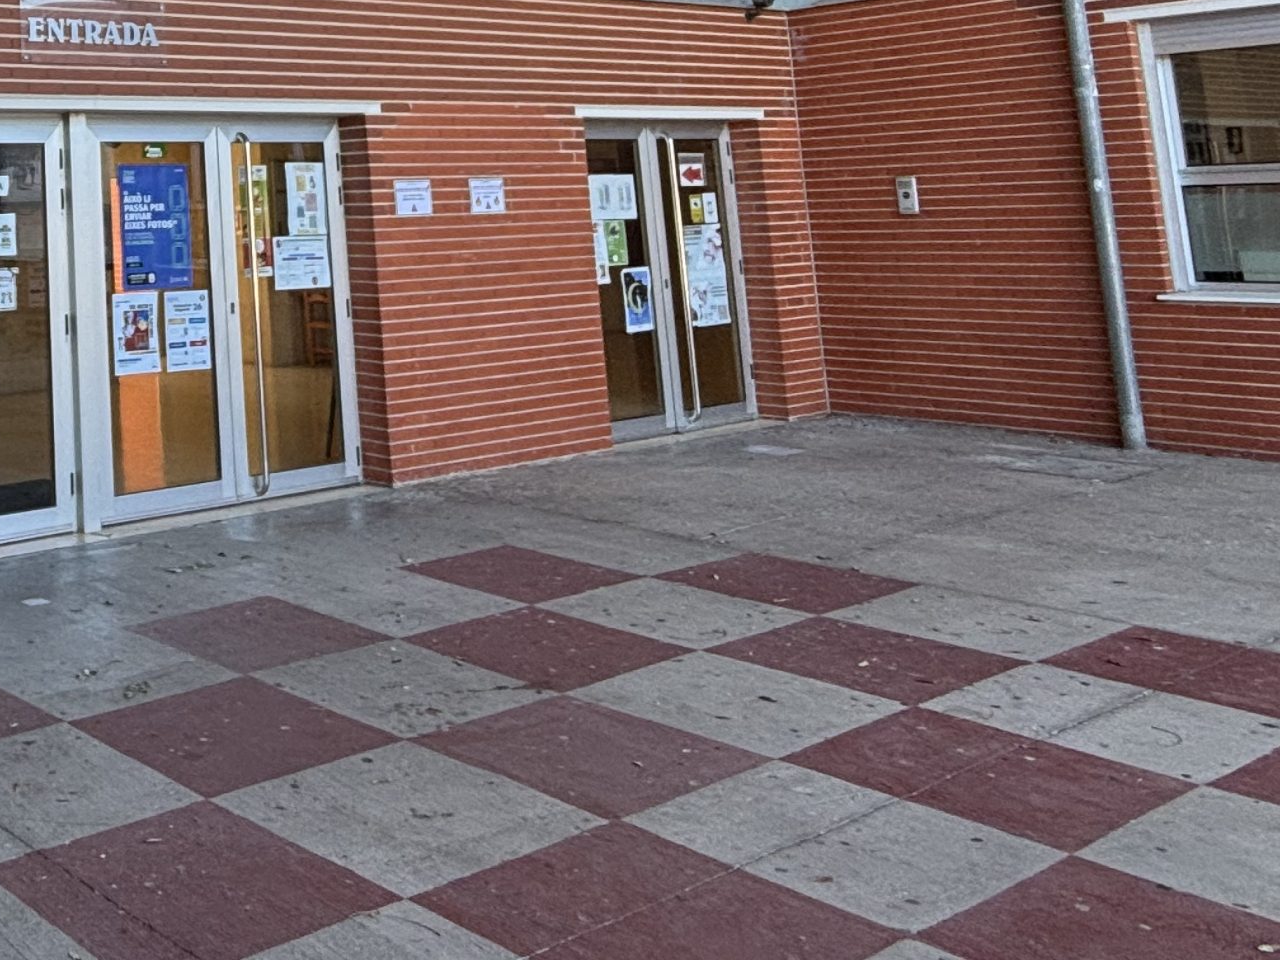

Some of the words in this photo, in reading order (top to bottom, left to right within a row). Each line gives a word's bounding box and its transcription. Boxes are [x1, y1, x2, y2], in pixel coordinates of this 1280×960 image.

[27, 16, 160, 47] ENTRADA
[124, 204, 148, 212] PASSA
[150, 202, 165, 211] PER
